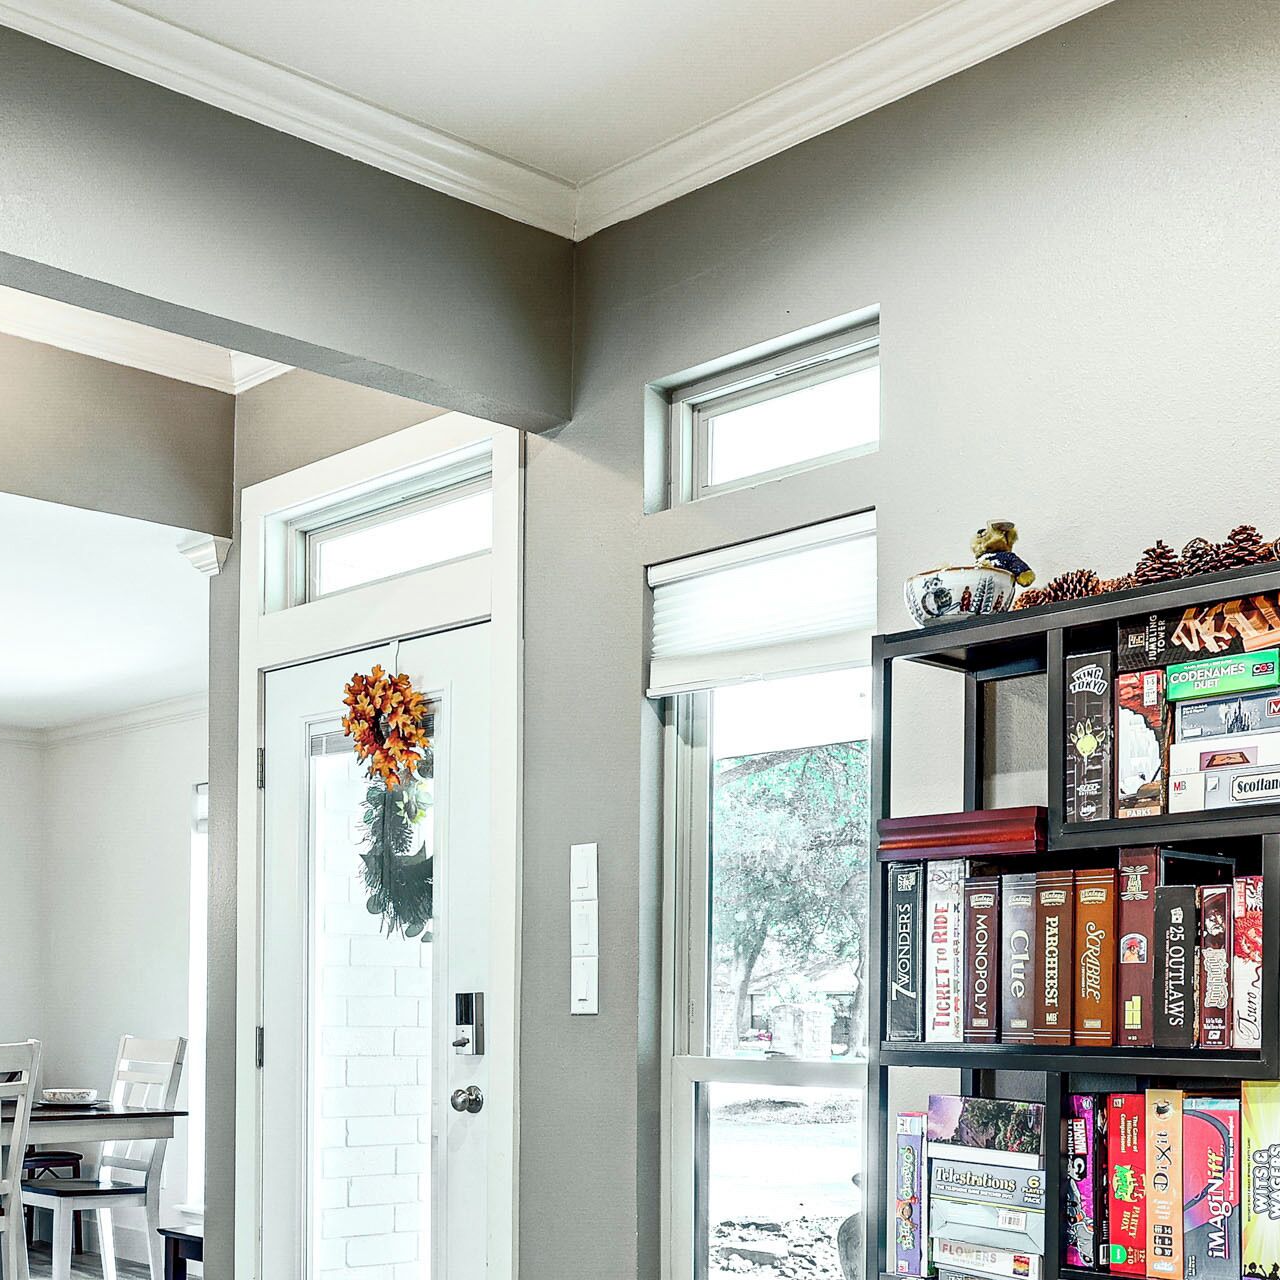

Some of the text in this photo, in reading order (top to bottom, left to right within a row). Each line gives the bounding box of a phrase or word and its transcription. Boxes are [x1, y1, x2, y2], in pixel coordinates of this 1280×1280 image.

[1149, 614, 1157, 661] JUMBLING
[1157, 619, 1165, 653] TOWER
[1070, 679, 1108, 695] TOKYO
[1170, 663, 1246, 685] CODENAMES
[1193, 678, 1220, 690] DUET
[1126, 809, 1151, 817] PARKS
[892, 903, 916, 1000] 7 WONDERS
[932, 902, 951, 1031] TICKET TO RIDE
[975, 914, 990, 1015] MONOPOLY
[1010, 929, 1030, 998] Clue
[1045, 916, 1059, 1007] PARCHEESI
[1082, 921, 1106, 1004] SCRABBLE
[1169, 926, 1185, 1026] 25 OUTLAWS
[1236, 992, 1261, 1041] Tsuro
[935, 1167, 1017, 1192] Telestrations
[1028, 1176, 1040, 1188] 6
[1121, 1210, 1131, 1231] BOX
[1129, 1206, 1140, 1239] PARTY
[942, 1244, 998, 1263] FLOWERS
